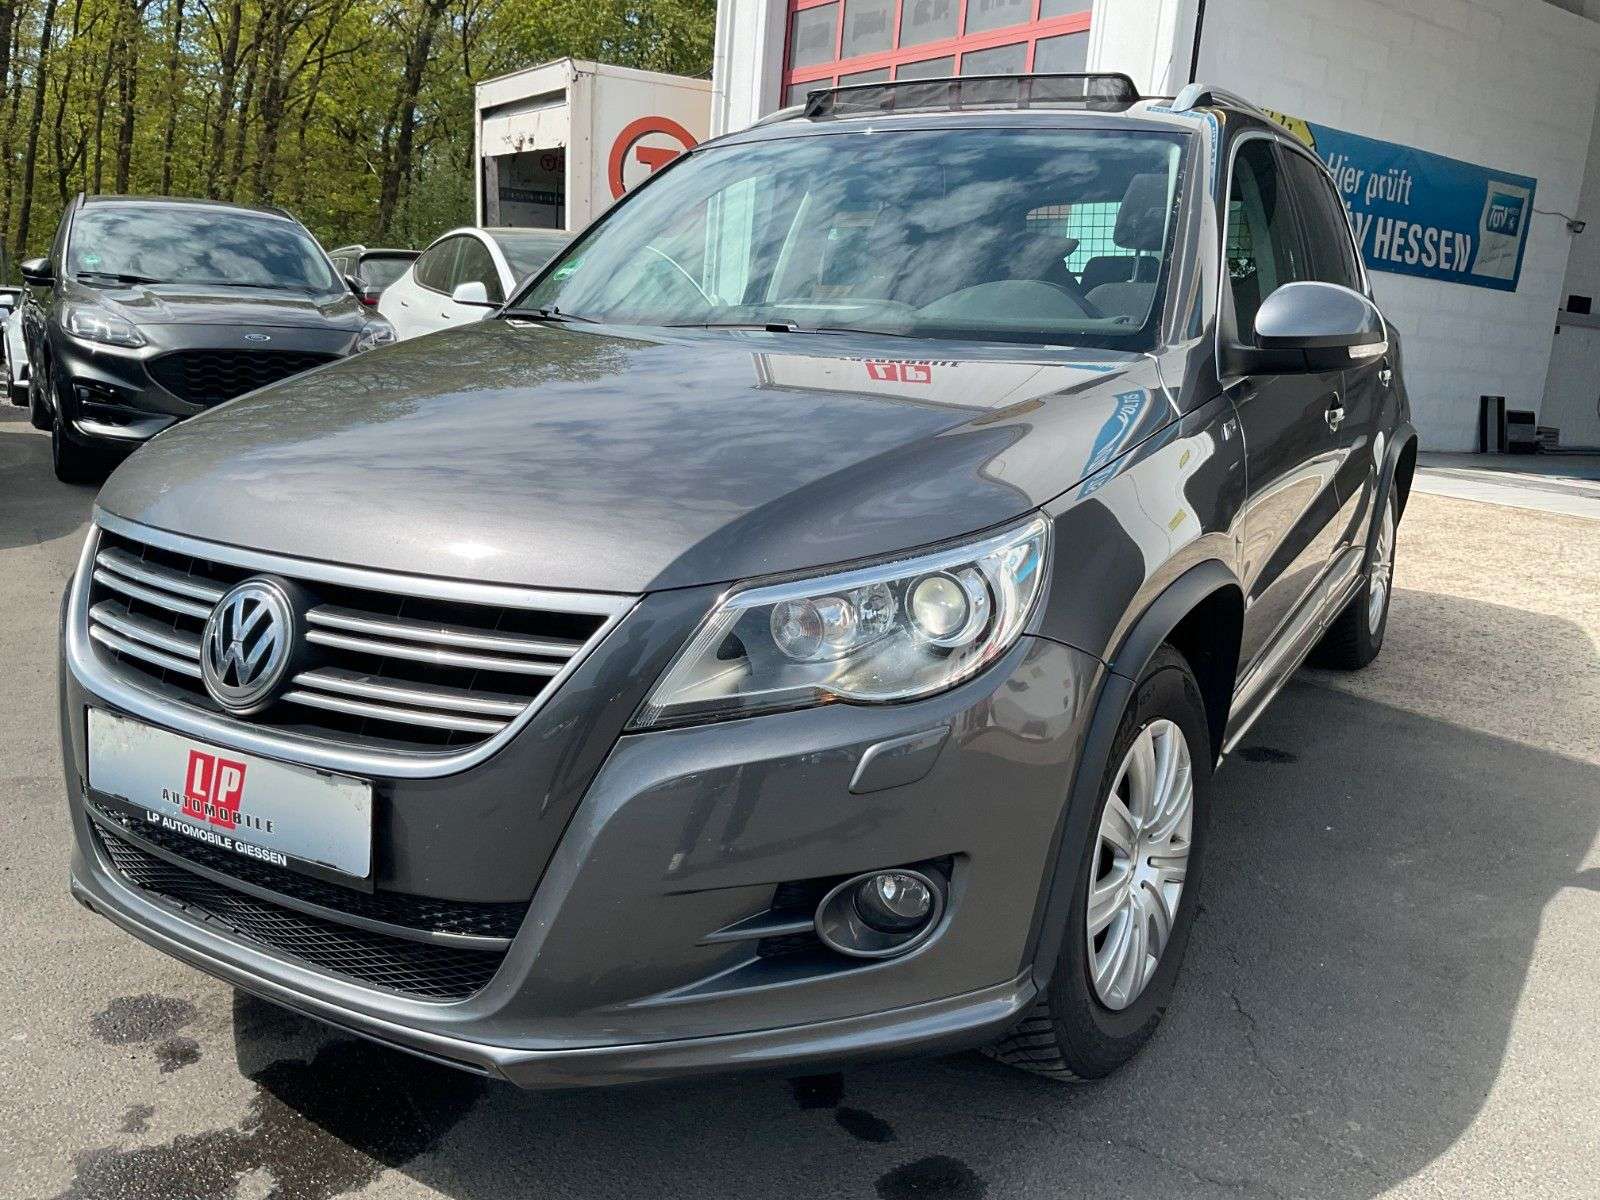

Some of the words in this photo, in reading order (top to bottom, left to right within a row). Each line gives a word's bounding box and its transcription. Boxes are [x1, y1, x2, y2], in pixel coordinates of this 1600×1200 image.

[1327, 152, 1364, 195] Hier
[1365, 168, 1412, 206] prüft
[1373, 216, 1472, 273] HESSEN
[191, 756, 242, 803] LP
[161, 786, 275, 834] AUTOMOBILE
[146, 810, 160, 824] LP
[162, 817, 232, 849] AUTOMOBILE
[234, 841, 287, 867] GIESSEN
